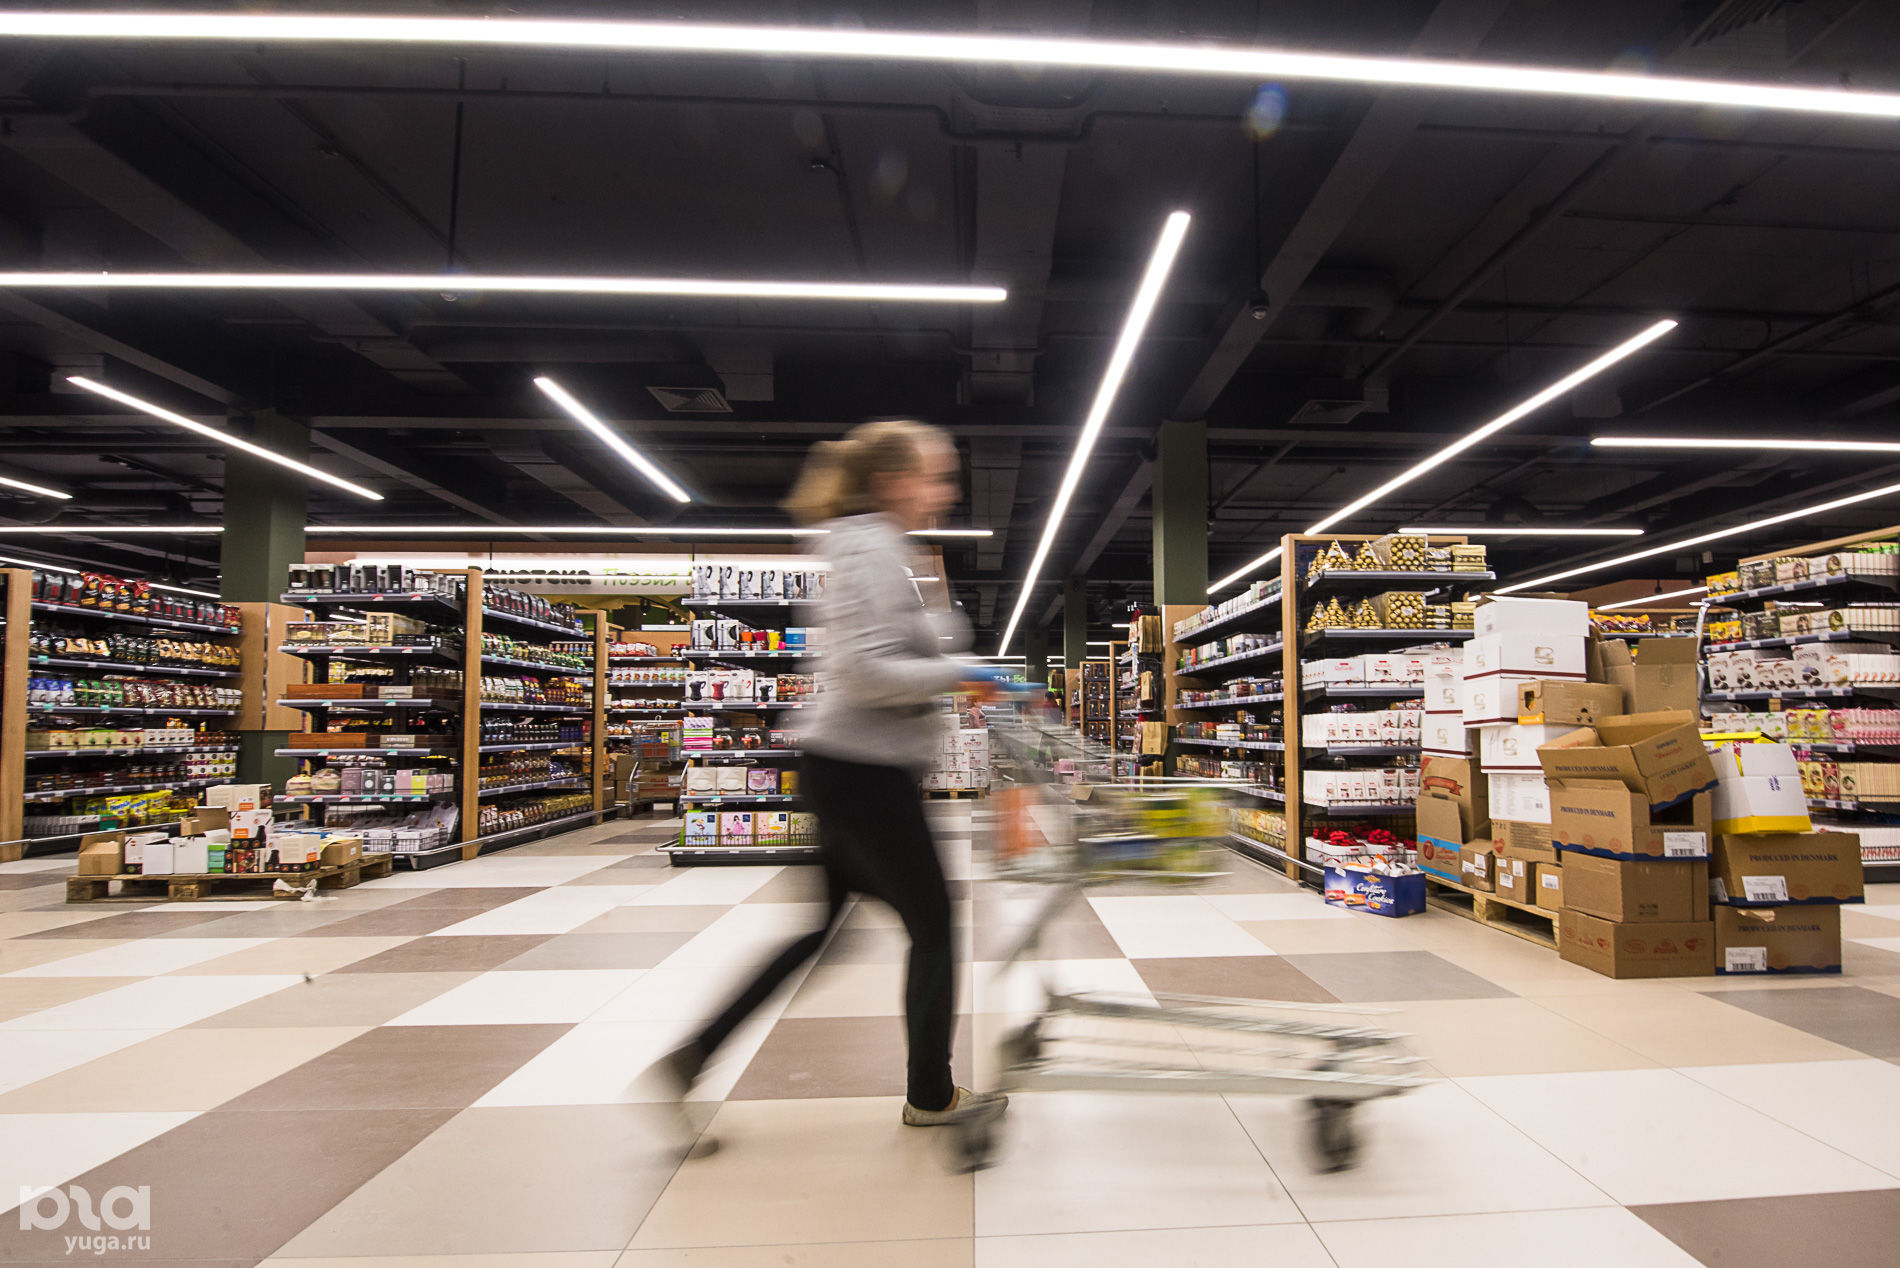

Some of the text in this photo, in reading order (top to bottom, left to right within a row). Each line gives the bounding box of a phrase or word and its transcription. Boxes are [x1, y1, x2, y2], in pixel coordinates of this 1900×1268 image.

[1560, 806, 1583, 814] PRODUCED
[1590, 809, 1615, 817] DENMARK
[1749, 854, 1790, 862] PRODUCED
[1801, 854, 1839, 862] DENMARK
